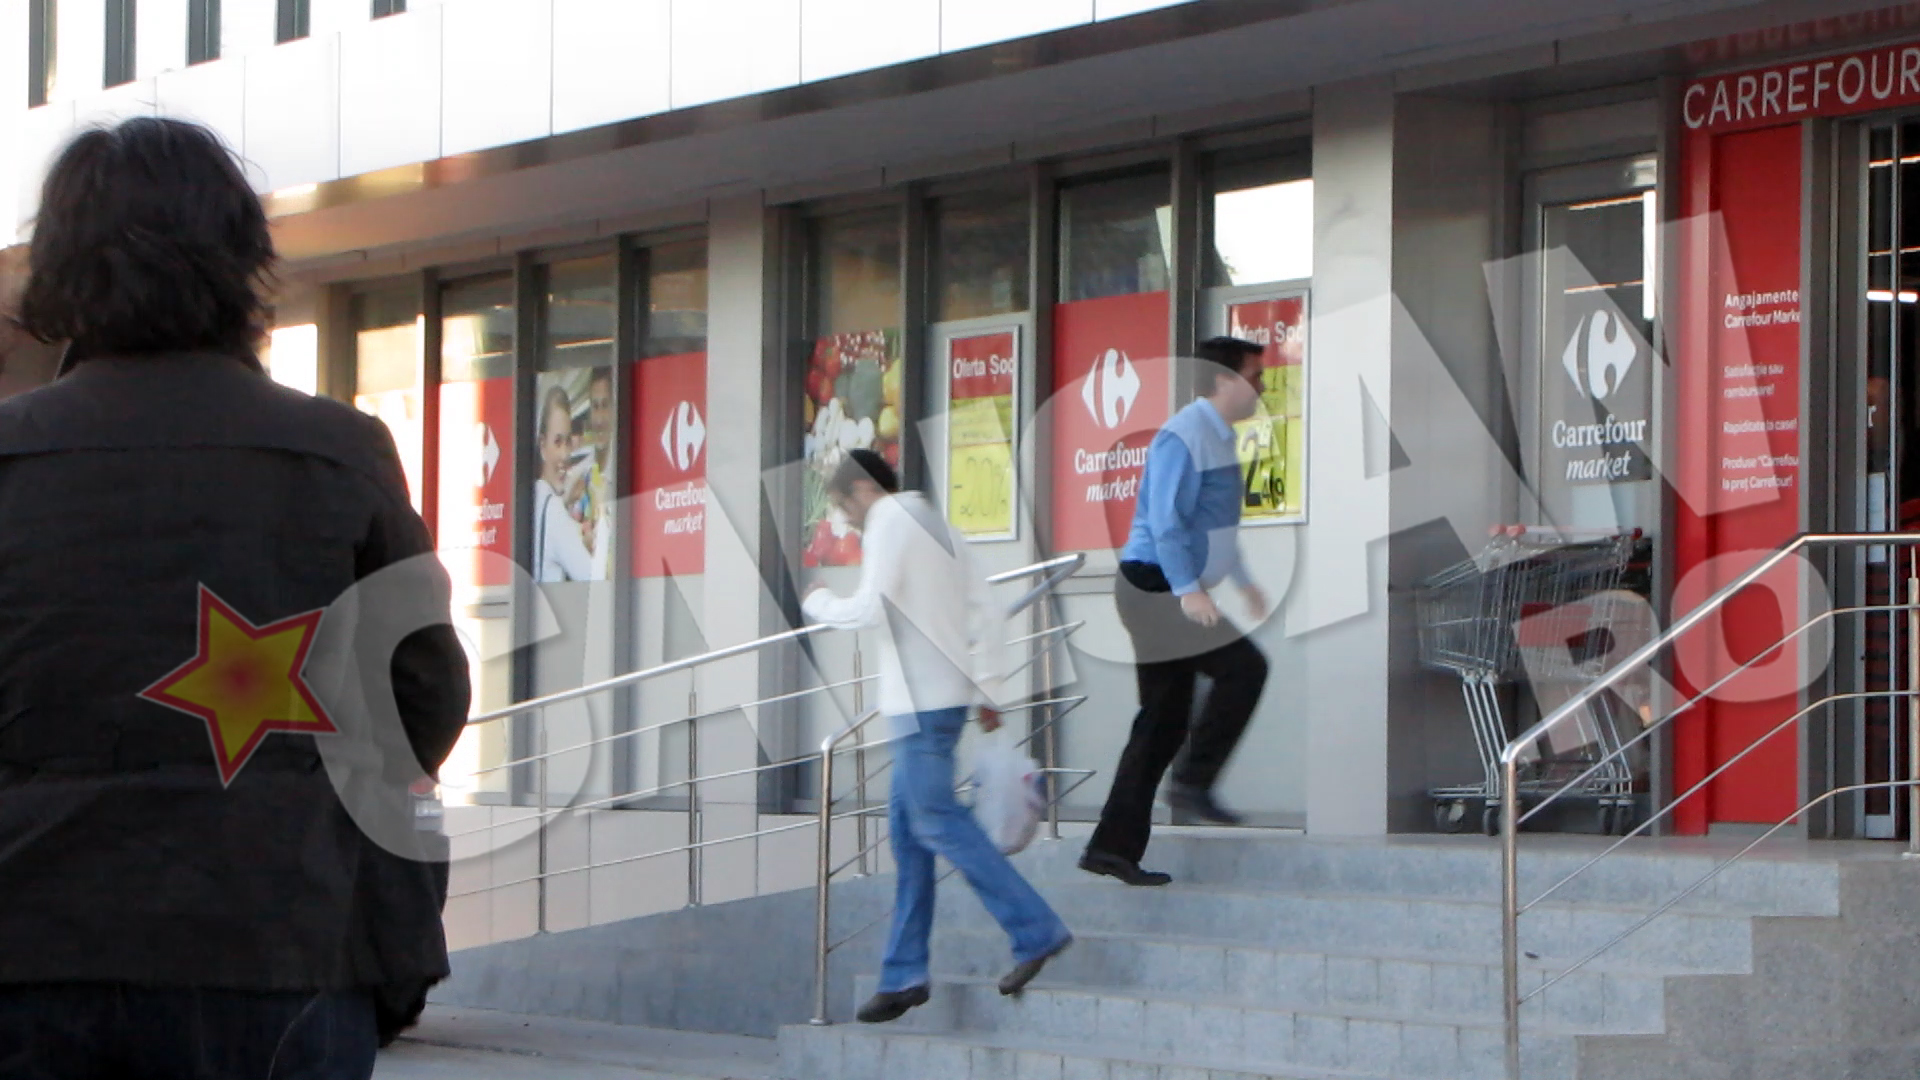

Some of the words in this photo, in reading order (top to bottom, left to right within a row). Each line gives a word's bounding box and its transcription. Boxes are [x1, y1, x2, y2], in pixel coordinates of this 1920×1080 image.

[1683, 47, 1920, 129] CARREFOUR
[1724, 311, 1771, 328] Carrefour
[953, 357, 986, 379] Oferta
[1552, 413, 1646, 448] Carrefour
[1074, 441, 1148, 474] Carrefour
[1565, 449, 1631, 480] market
[655, 481, 707, 511] Carrefou
[1086, 474, 1137, 502] market
[664, 511, 703, 535] market
